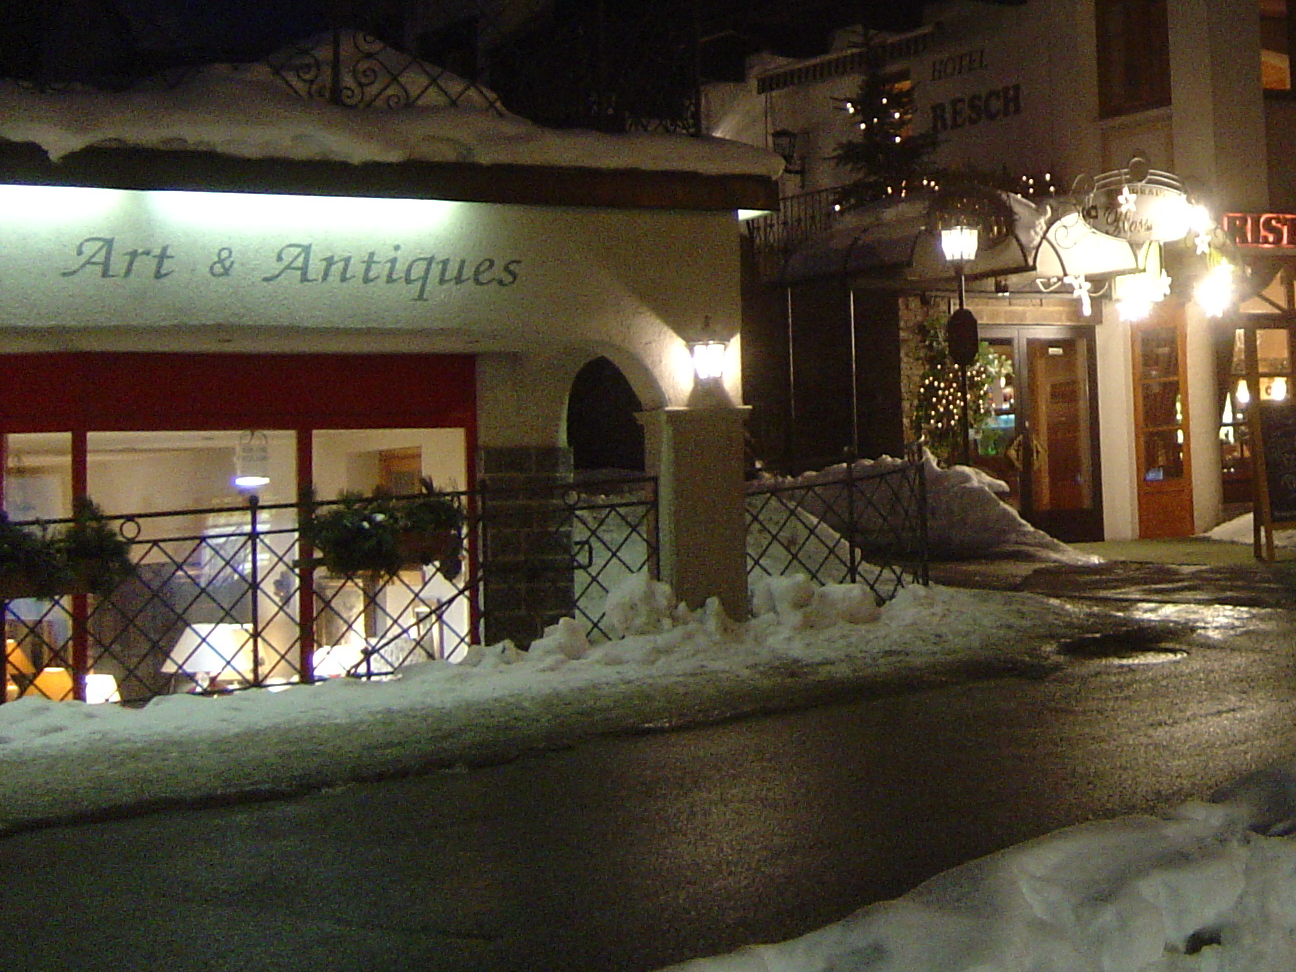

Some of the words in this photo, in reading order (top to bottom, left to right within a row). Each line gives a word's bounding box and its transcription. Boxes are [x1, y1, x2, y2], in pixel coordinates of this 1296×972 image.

[931, 49, 989, 81] HOTEL
[930, 83, 1021, 133] RESCH
[60, 236, 176, 280] Art
[209, 246, 237, 278] &
[261, 242, 524, 303] Antiques
